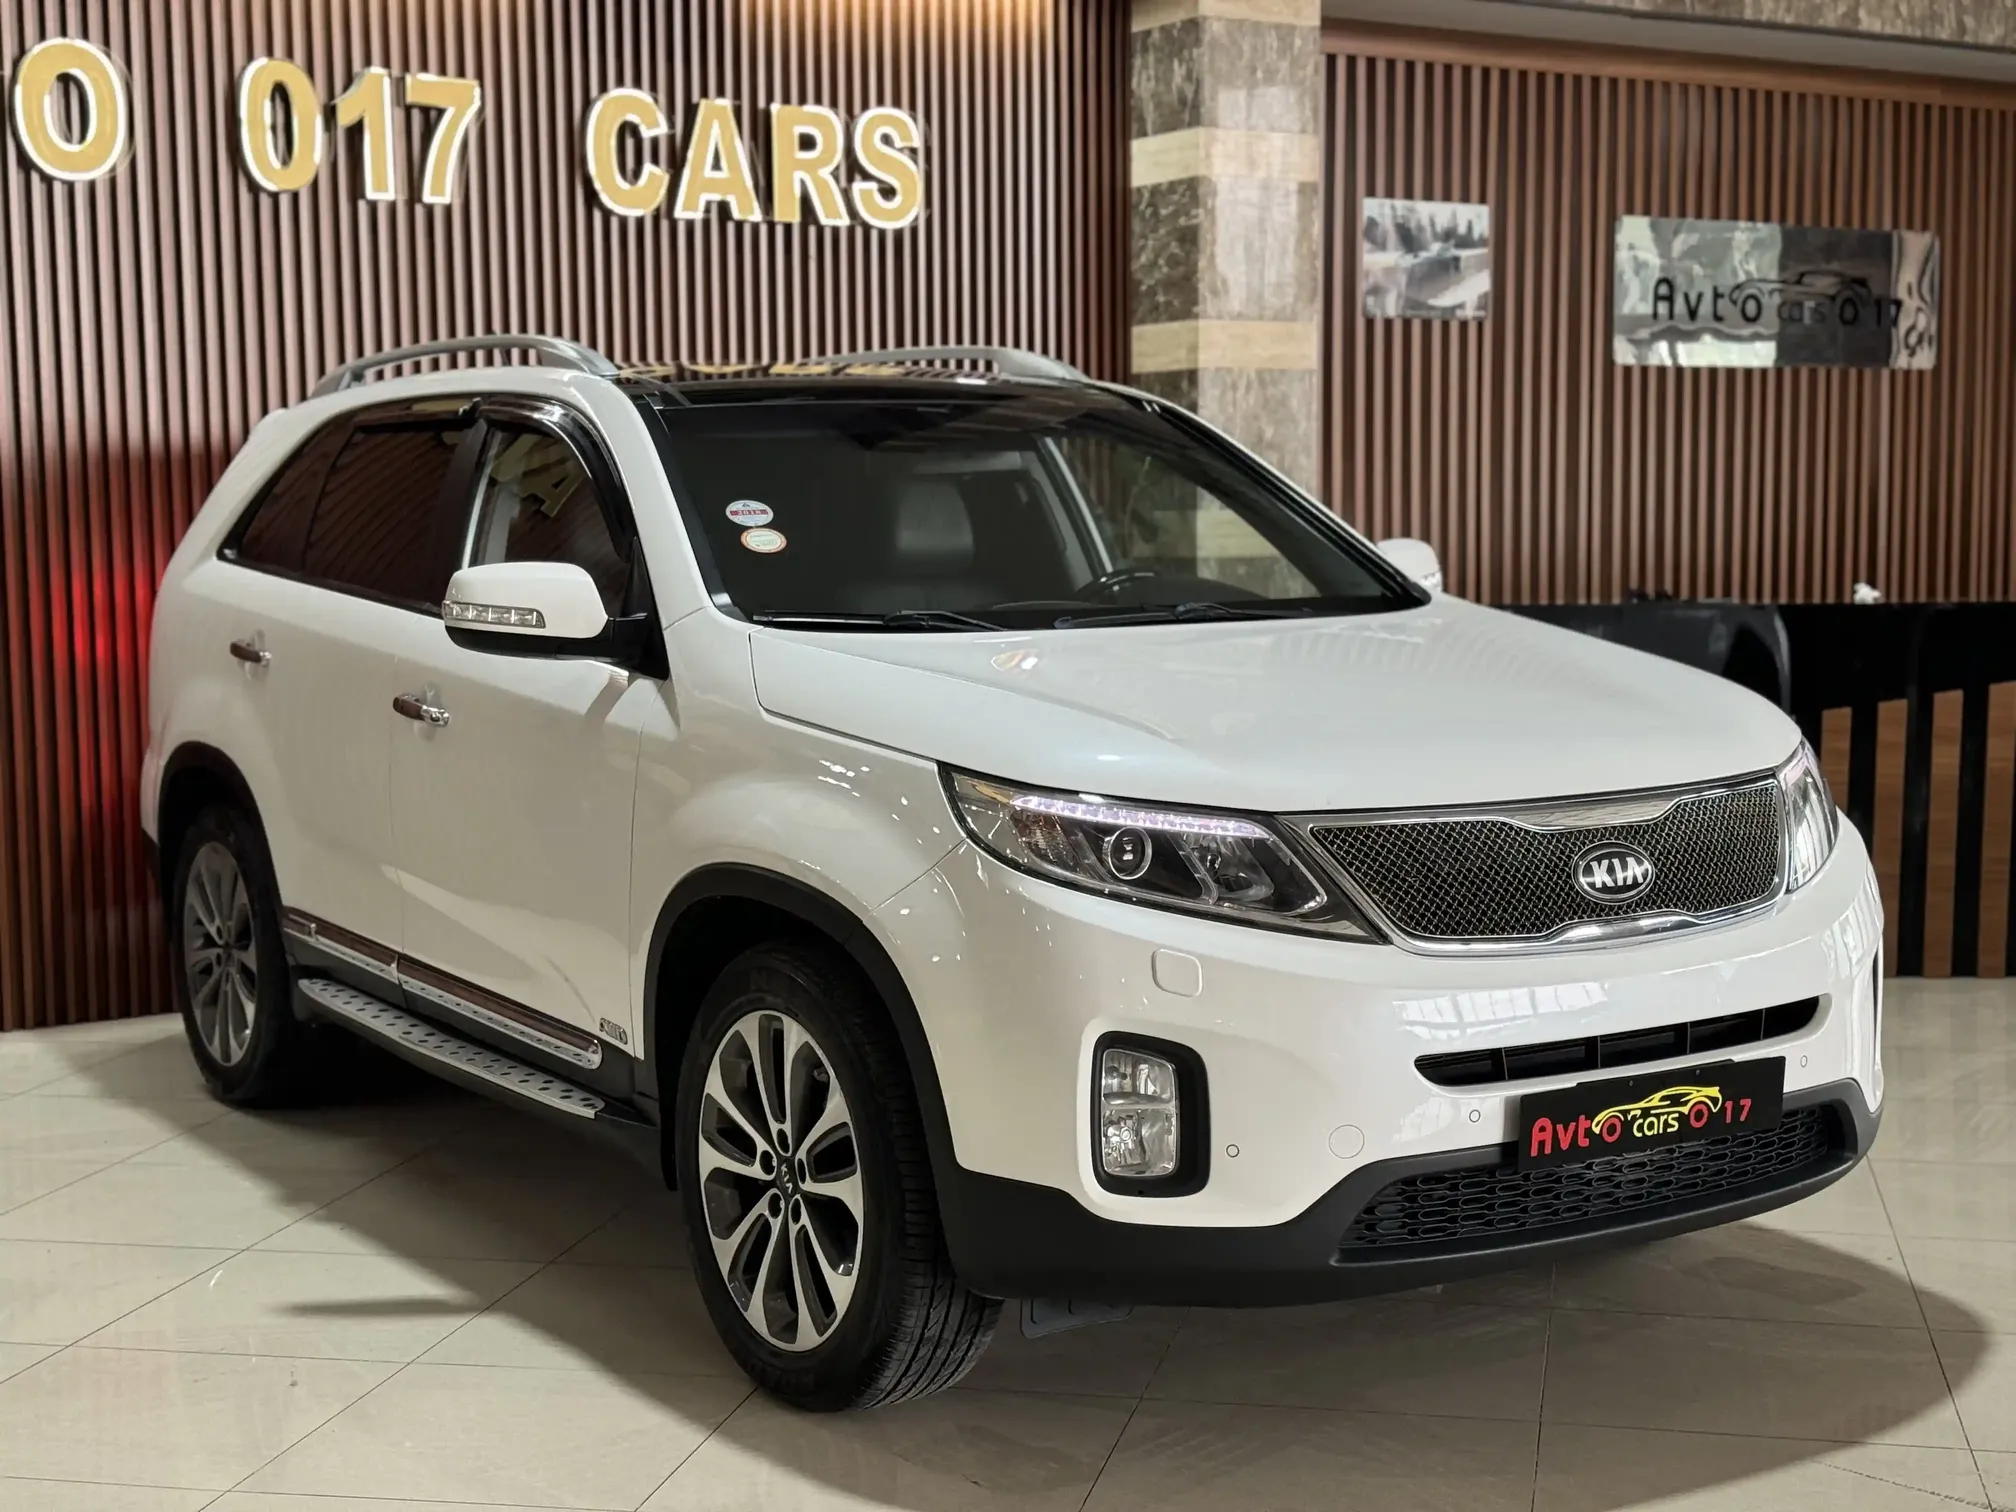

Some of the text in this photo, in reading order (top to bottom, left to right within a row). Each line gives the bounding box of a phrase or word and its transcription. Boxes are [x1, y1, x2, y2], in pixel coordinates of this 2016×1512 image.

[239, 56, 482, 205] 017
[586, 86, 922, 231] CARS
[1590, 857, 1644, 889] KIA
[1632, 1110, 1680, 1138] cars
[781, 1163, 793, 1194] KIA
